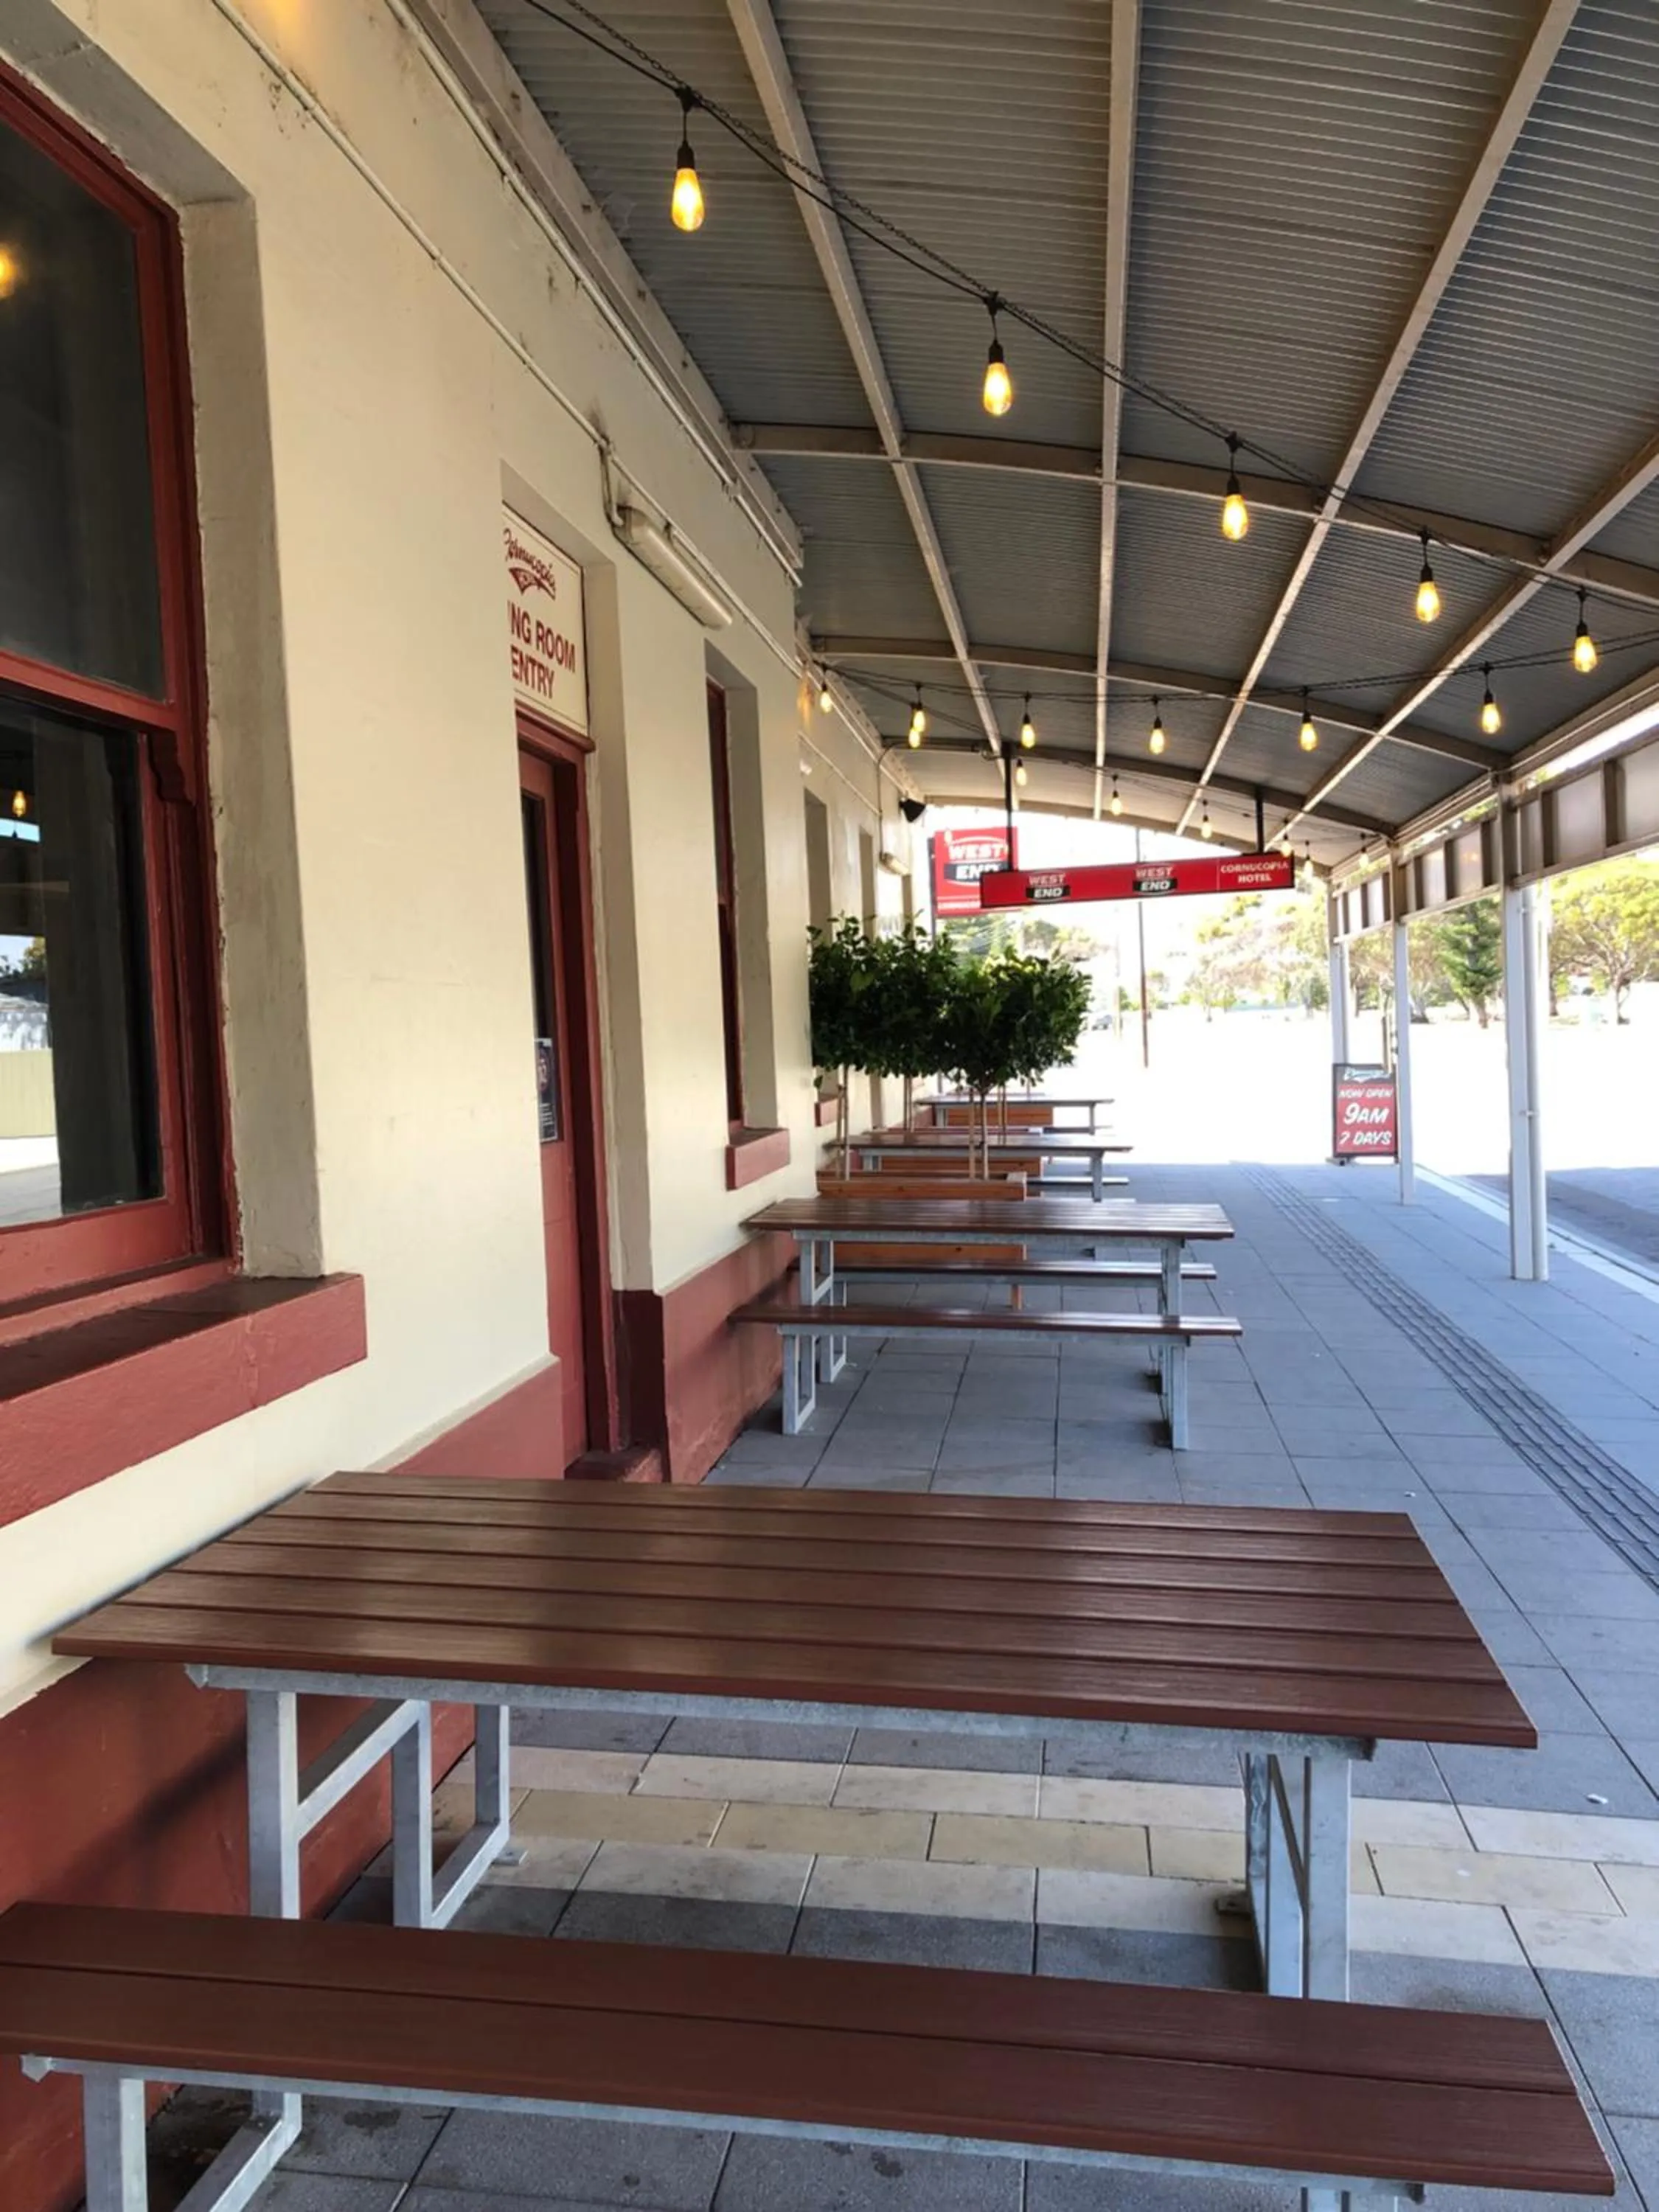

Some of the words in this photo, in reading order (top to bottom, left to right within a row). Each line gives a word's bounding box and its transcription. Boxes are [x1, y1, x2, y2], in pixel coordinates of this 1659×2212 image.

[536, 619, 576, 674] ROOM
[510, 644, 555, 699] ENTRY
[948, 843, 1009, 860] WEST
[1135, 866, 1173, 878] WEST
[1220, 860, 1289, 874] CORNUCOPIA
[1029, 873, 1066, 886] WEST
[1238, 872, 1272, 883] HOTEL
[1141, 880, 1171, 891] END
[1034, 887, 1062, 898] END
[1339, 1088, 1365, 1099] NOW
[1366, 1088, 1393, 1099] OPEN
[1343, 1102, 1390, 1125] 9AM
[1339, 1131, 1350, 1144] 7
[1353, 1130, 1392, 1145] DAYS
